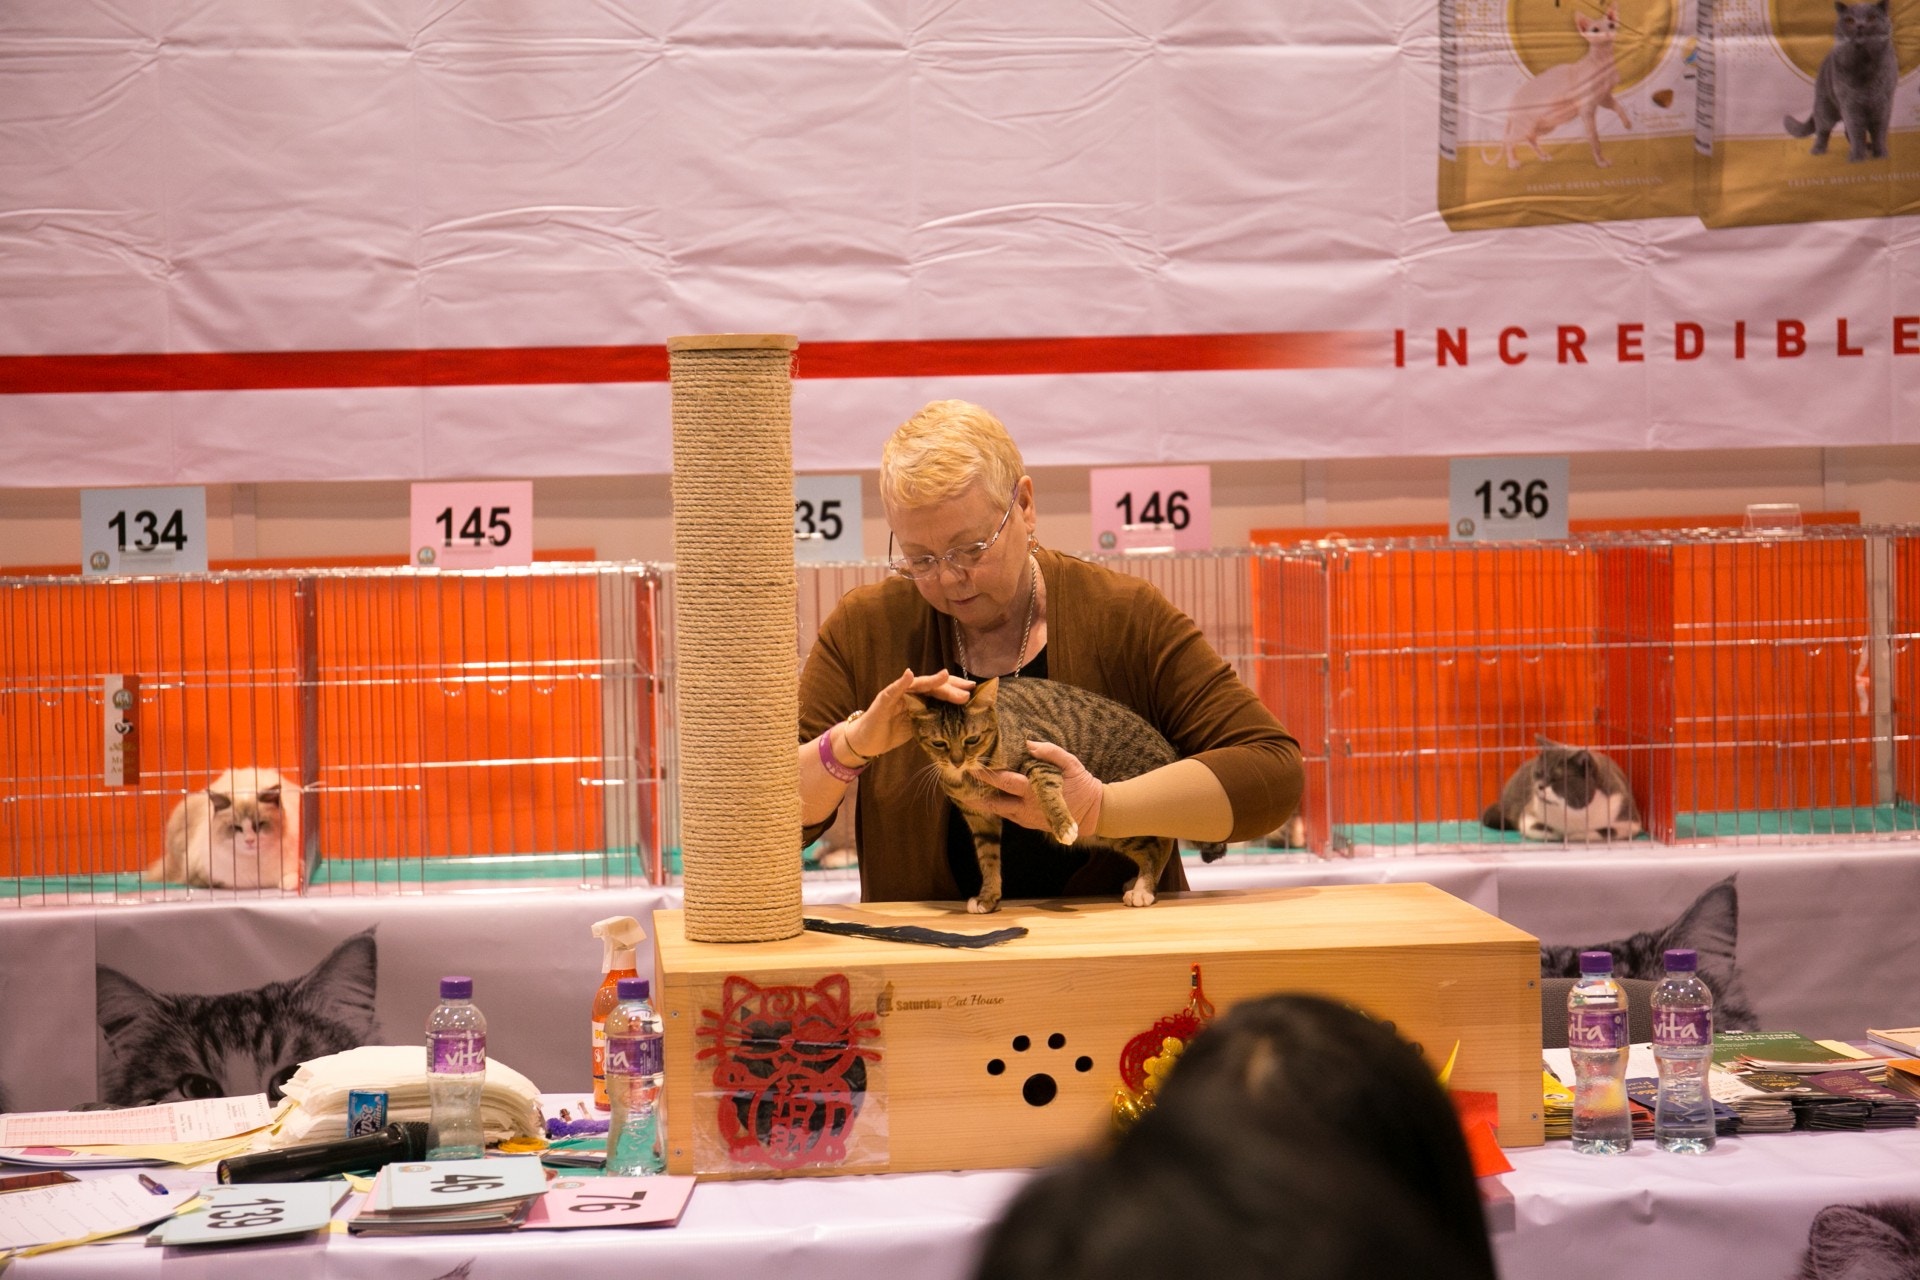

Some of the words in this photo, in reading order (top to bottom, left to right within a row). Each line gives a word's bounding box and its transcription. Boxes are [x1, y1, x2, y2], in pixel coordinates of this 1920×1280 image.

[1394, 316, 1920, 367] INCREDIBLE
[1116, 490, 1190, 531] 146
[1474, 479, 1549, 519] 136
[108, 509, 188, 552] 134
[435, 506, 511, 547] 145
[794, 500, 843, 540] 35
[896, 999, 943, 1011] Saturday
[946, 995, 968, 1009] Cat
[970, 994, 1005, 1006] House
[1653, 1012, 1700, 1039] vita
[430, 1173, 504, 1194] 46
[568, 1190, 647, 1213] 76
[207, 1198, 286, 1229] 139
